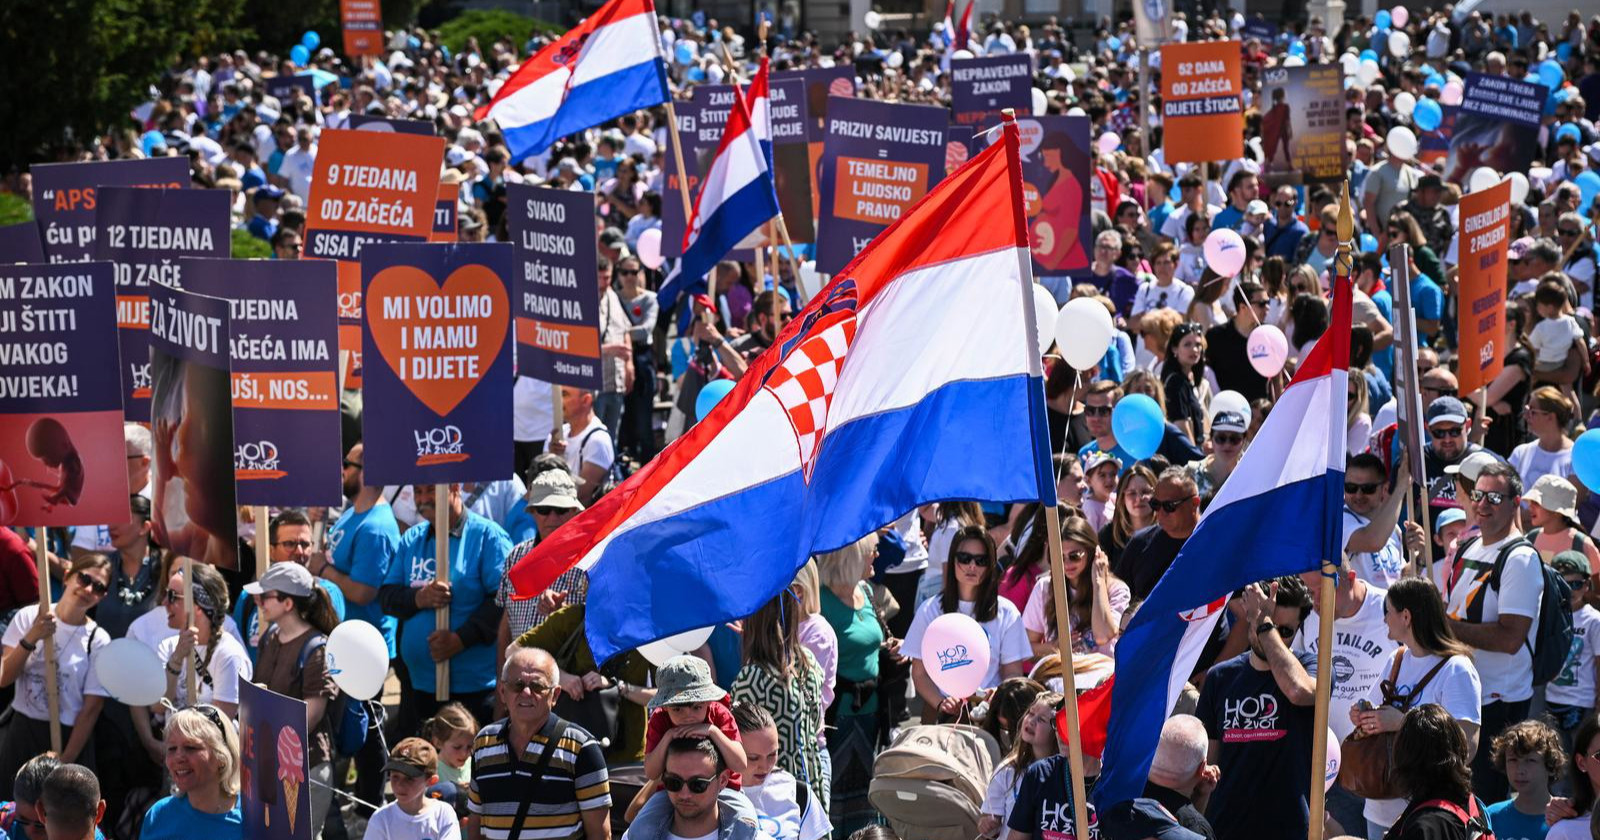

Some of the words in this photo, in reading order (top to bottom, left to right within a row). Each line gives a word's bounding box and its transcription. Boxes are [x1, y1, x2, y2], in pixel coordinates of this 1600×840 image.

[954, 64, 1028, 81] NEPRAVEDAN
[1178, 62, 1193, 76] 52
[1195, 60, 1226, 75] DANA
[972, 80, 1011, 95] ZAKON
[1172, 82, 1188, 96] OD
[1190, 76, 1232, 95] ZAČEĆA
[771, 105, 799, 119] JUDE
[1165, 100, 1203, 116] DIJETE
[1204, 97, 1240, 113] ŠTUCA
[830, 119, 874, 139] PRIZIV
[875, 125, 942, 146] SAVIJESTI
[327, 164, 340, 186] 9
[343, 164, 417, 192] TJEDANA
[848, 161, 917, 182] TEMELJNO
[852, 180, 912, 201] LJUDSKO
[321, 198, 344, 220] OD
[344, 196, 415, 228] ZAČEĆA
[526, 199, 566, 223] SVAKO
[856, 200, 901, 220] PRAVO
[46, 222, 73, 245] ću
[107, 225, 126, 248] 12
[129, 226, 214, 250] TJEDANA
[313, 233, 349, 257] SISA
[522, 229, 576, 256] LJUDSKO
[1470, 237, 1477, 254] 2
[135, 259, 182, 287] ZAČE
[524, 259, 550, 285] BIĆE
[550, 266, 578, 288] IMA
[20, 275, 94, 299] ZAKON
[21, 304, 77, 332] ŠTITI
[229, 299, 299, 320] TJEDNA
[383, 296, 410, 319] MI
[415, 294, 493, 319] VOLIMO
[523, 292, 561, 318] PRAVO
[562, 300, 583, 320] NA
[152, 299, 167, 339] ZA
[168, 297, 222, 354] ŽIVOT
[401, 326, 408, 350] I
[413, 325, 477, 350] MAMU
[535, 321, 570, 350] ŽIVOT
[0, 342, 69, 365] VAKOG
[230, 334, 287, 360] AČEĆA
[291, 340, 330, 360] IMA
[400, 357, 406, 380] I
[412, 355, 480, 380] DIJETE
[553, 361, 581, 375] -Ustav
[581, 364, 594, 377] RH
[269, 379, 329, 400] NOS...
[414, 425, 463, 450] HOD
[412, 556, 437, 576] HO
[936, 644, 968, 662] HOD
[1337, 632, 1383, 659] TAILOR
[1341, 684, 1371, 693] QUALITY
[1225, 693, 1278, 720] HOD
[1223, 716, 1240, 729] ZA
[1041, 819, 1059, 832] ZA
